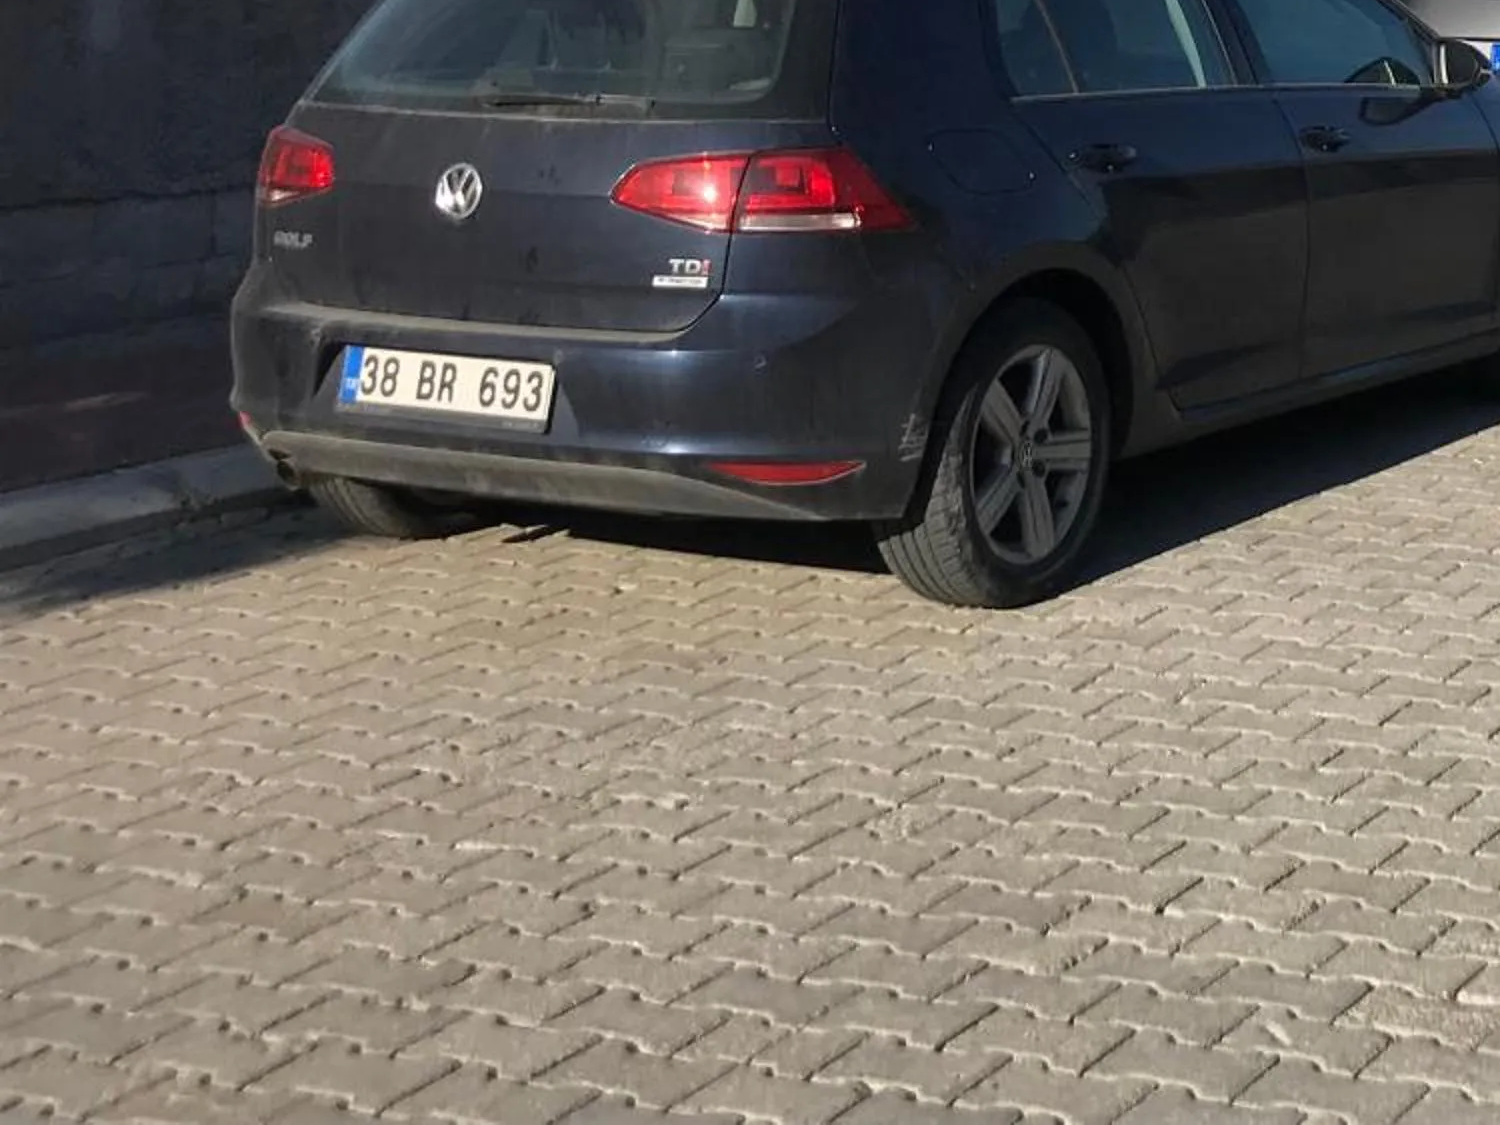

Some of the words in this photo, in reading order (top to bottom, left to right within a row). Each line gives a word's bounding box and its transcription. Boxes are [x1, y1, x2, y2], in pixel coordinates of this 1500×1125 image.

[361, 355, 400, 397] 38
[416, 360, 457, 403] BR
[479, 367, 543, 411] 693
